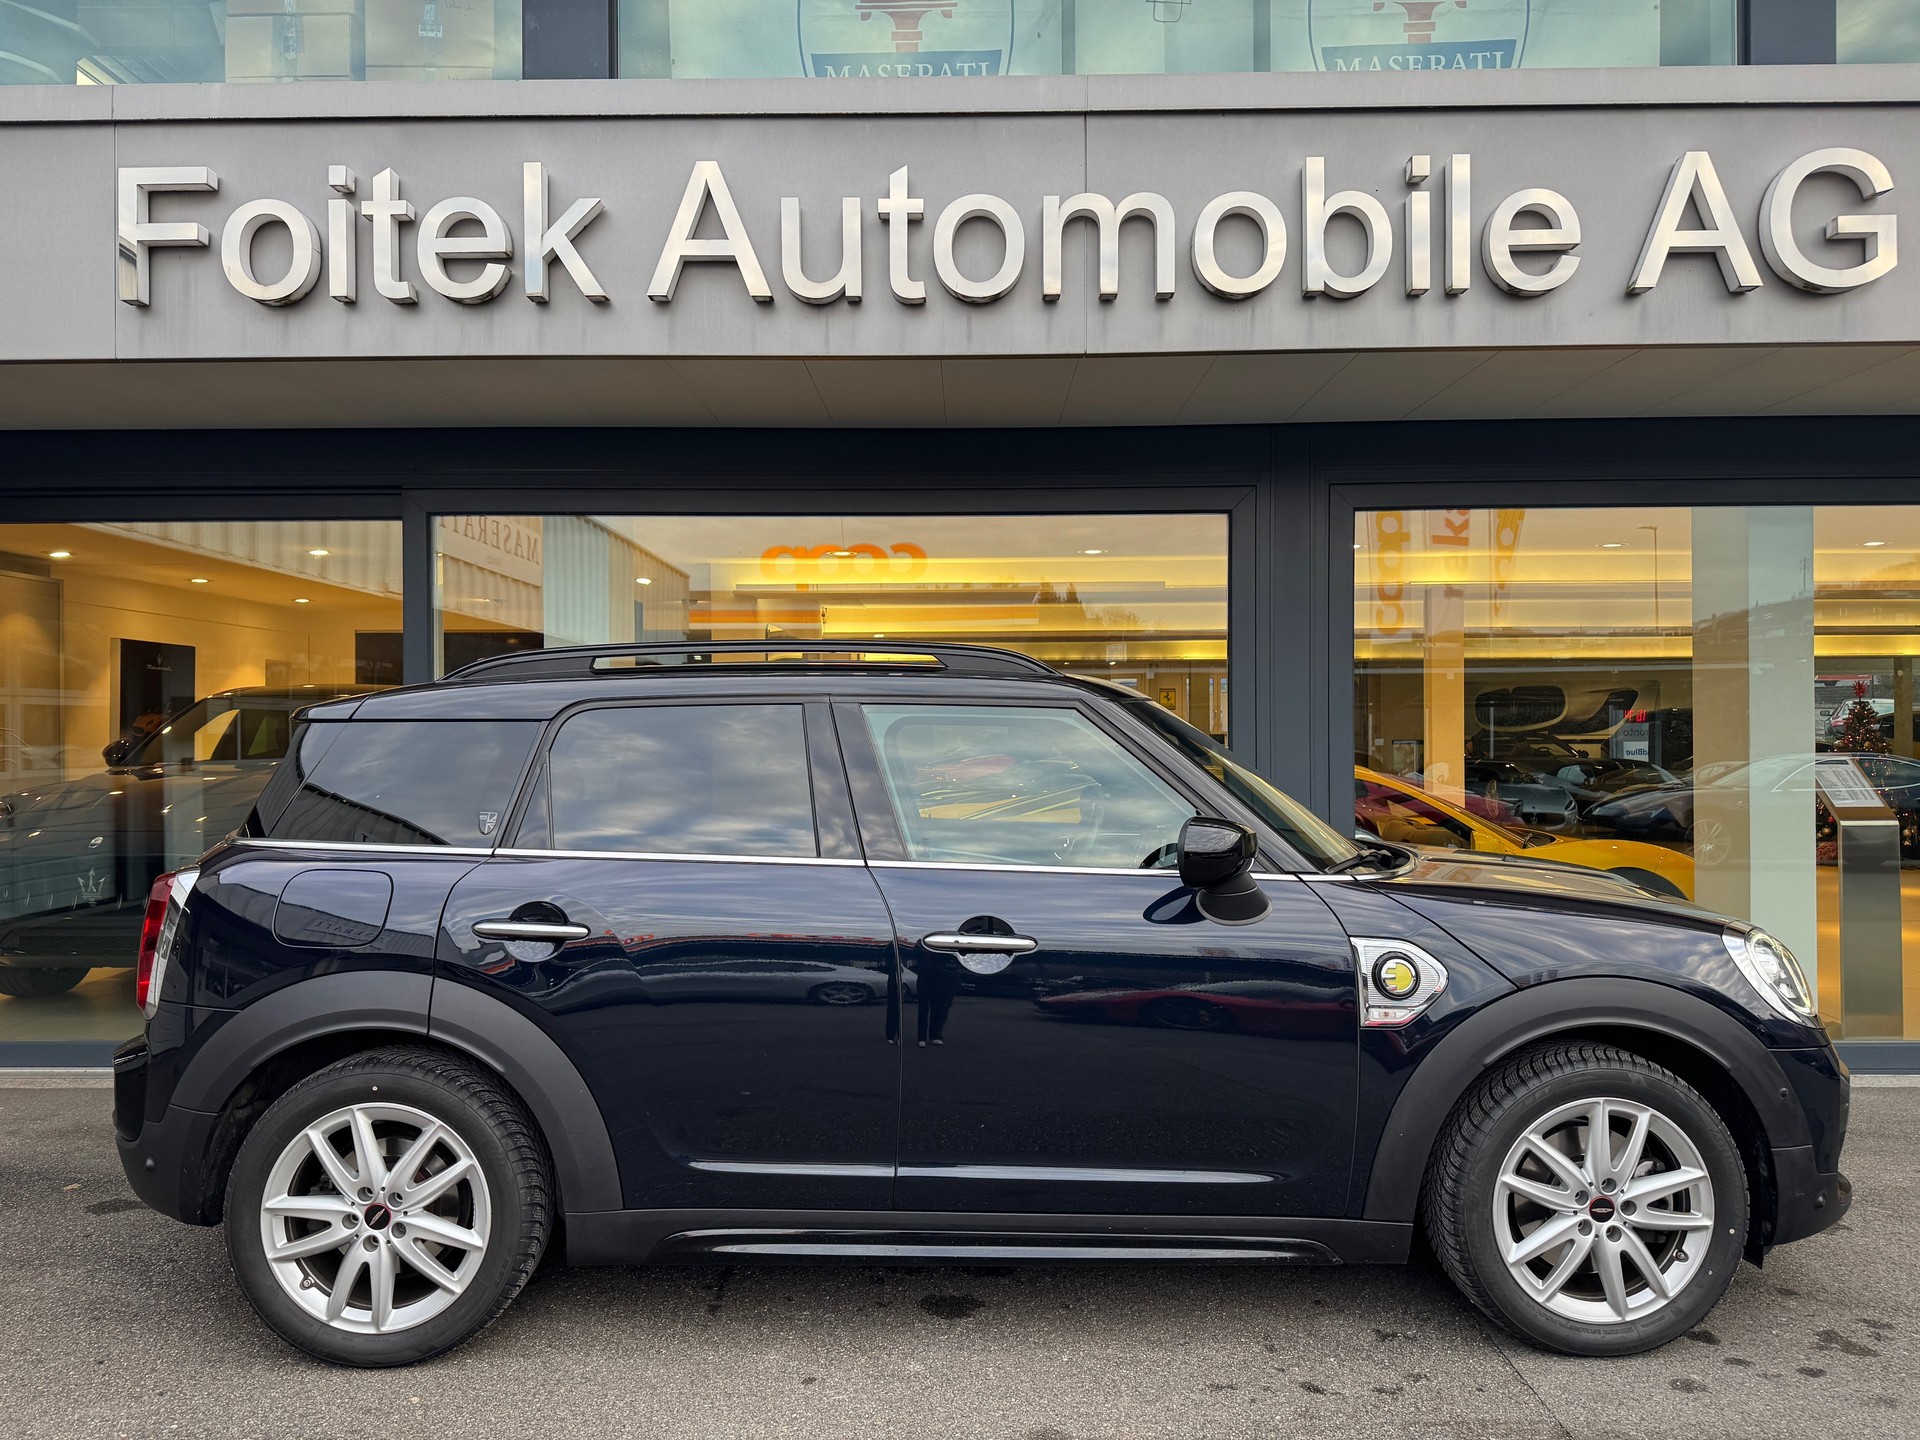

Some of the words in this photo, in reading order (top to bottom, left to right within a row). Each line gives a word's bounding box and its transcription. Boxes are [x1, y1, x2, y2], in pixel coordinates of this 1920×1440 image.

[824, 61, 990, 77] MASERATI
[1334, 51, 1505, 71] MASERATI
[118, 161, 610, 306] Foitek
[646, 153, 1582, 305] Automobile
[1626, 147, 1898, 294] AG
[1376, 511, 1410, 635] coop
